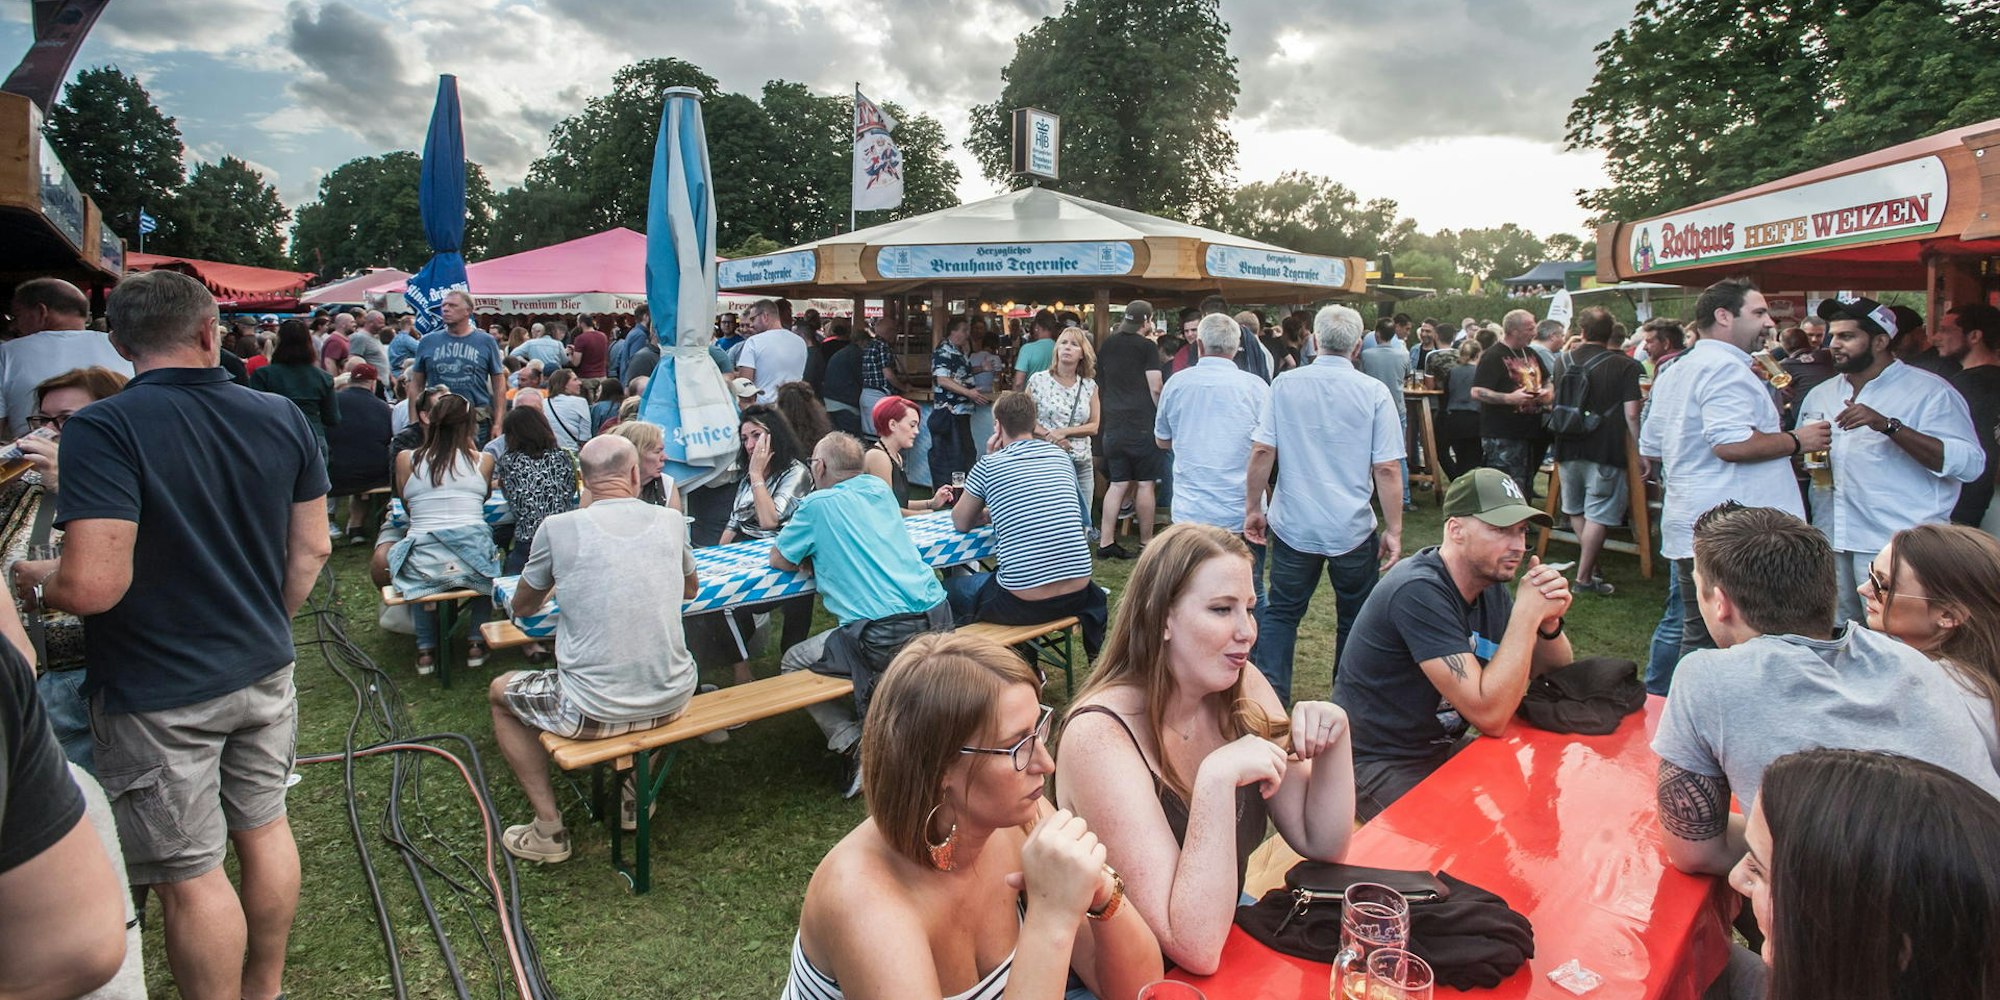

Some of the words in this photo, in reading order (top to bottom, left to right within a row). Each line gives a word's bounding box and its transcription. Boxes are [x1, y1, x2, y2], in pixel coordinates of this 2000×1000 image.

[1660, 222, 1735, 261] Rothaus
[1744, 216, 1808, 249] HEFE
[1811, 193, 1933, 238] WEIZEN
[976, 245, 1032, 257] Herzogliches
[930, 257, 1003, 275] Brauhaus
[1007, 256, 1079, 275] Tegernsee
[1239, 260, 1281, 278] Brauhaus
[512, 299, 557, 310] Premium
[561, 299, 581, 310] Bier
[433, 342, 480, 364] GASOLINE
[1501, 478, 1523, 499] NY
